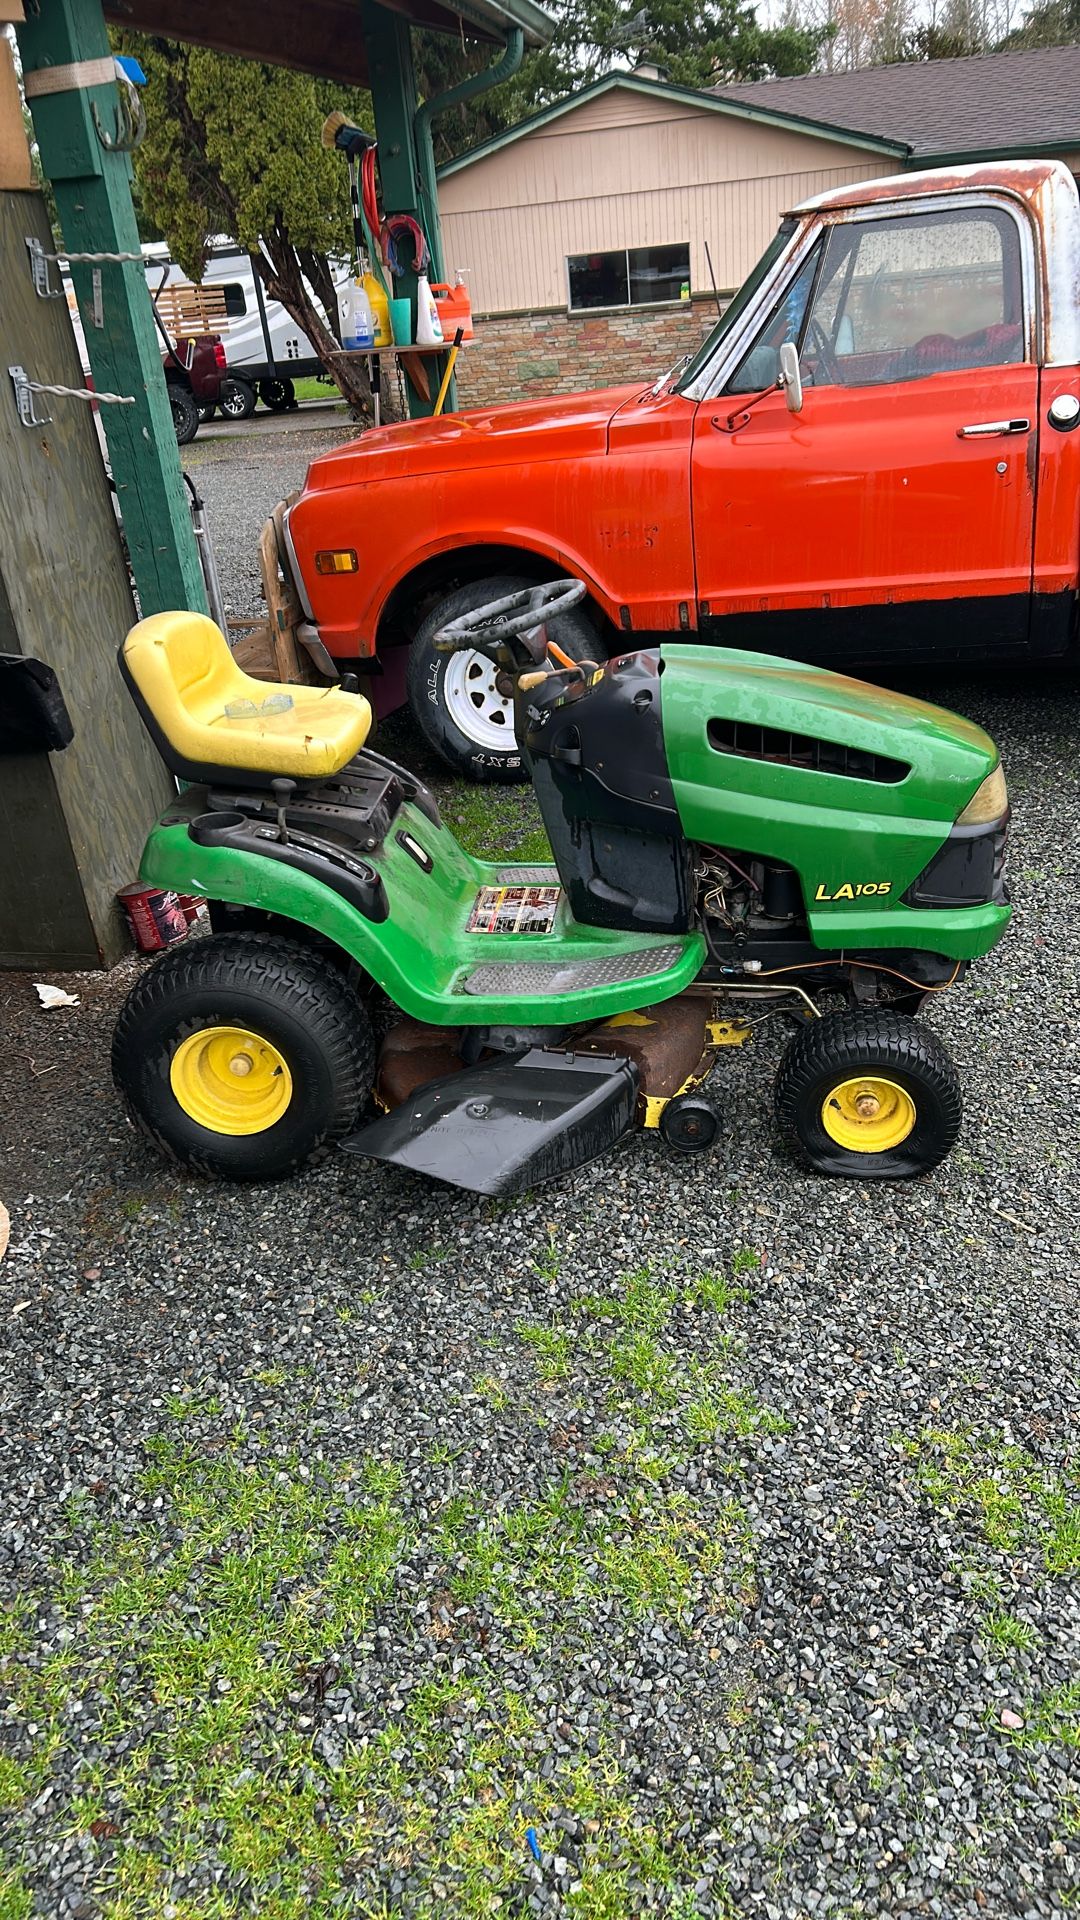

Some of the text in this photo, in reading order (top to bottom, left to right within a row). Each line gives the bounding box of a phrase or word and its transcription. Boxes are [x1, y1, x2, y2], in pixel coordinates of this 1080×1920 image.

[427, 658, 442, 706] ALL
[471, 752, 522, 768] SXT
[814, 881, 893, 901] LA105
